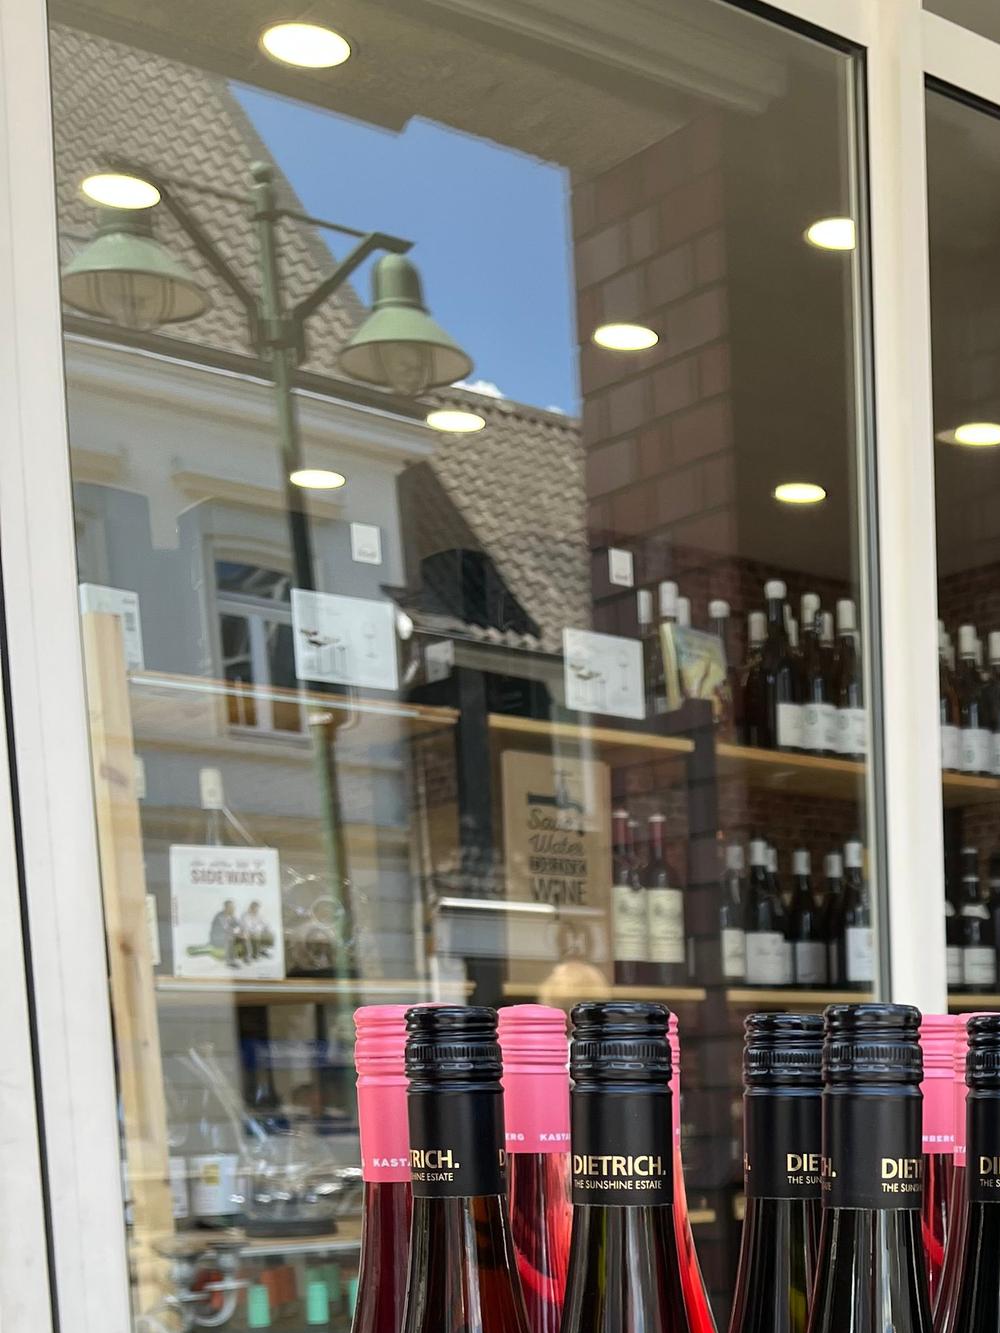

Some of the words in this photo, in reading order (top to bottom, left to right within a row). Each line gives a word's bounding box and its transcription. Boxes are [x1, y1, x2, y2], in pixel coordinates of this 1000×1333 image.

[574, 1155, 667, 1176] DIETRICH.
[426, 1172, 454, 1181] ESTATE
[788, 1176, 804, 1185] THE
[586, 1180, 633, 1190] SUNSHINE
[635, 1180, 662, 1190] ESTATE
[882, 1183, 899, 1192] THE
